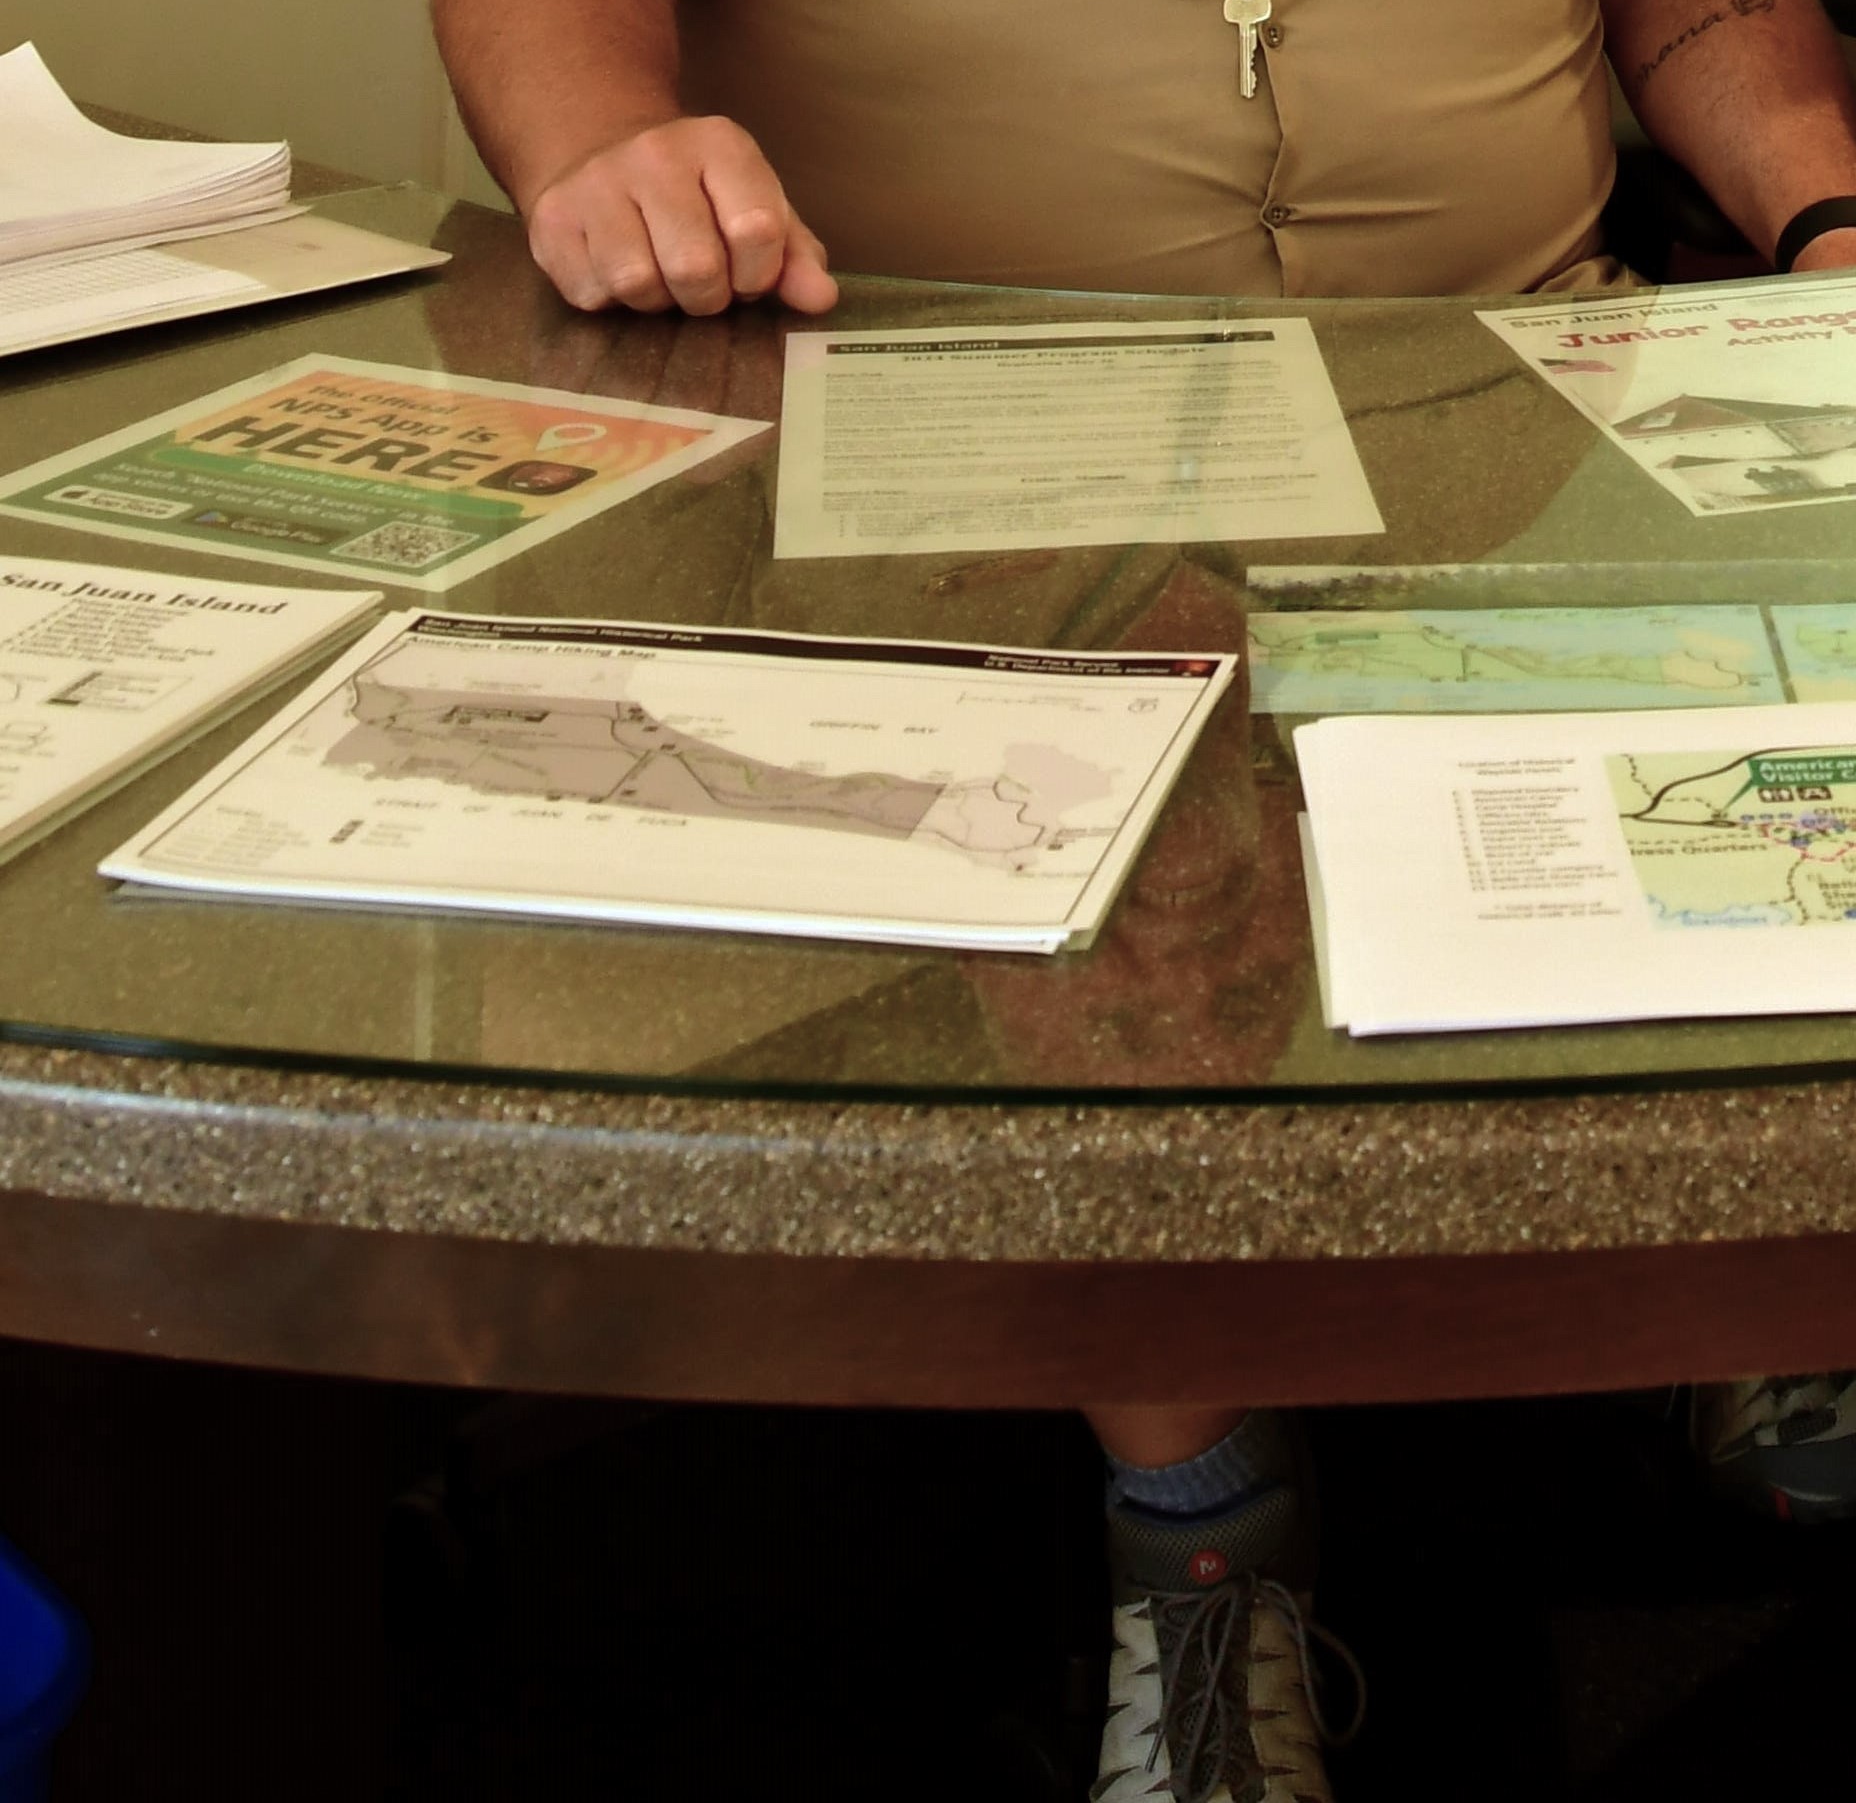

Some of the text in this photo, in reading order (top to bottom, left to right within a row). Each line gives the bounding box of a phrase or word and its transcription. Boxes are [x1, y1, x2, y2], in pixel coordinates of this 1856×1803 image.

[1510, 302, 1718, 329] San Juan Island
[838, 340, 1000, 353] San Juan Island
[1557, 324, 1709, 348] Junior
[1728, 329, 1833, 347] Activity
[950, 352, 1030, 362] Summer
[1034, 350, 1119, 359] Program
[1123, 347, 1206, 356] Schedule
[308, 385, 461, 416] The Official
[268, 397, 500, 444] NPS App is
[192, 416, 501, 482] HERE
[243, 462, 368, 496] Download
[1, 573, 290, 615] San Juan Island
[423, 617, 704, 643] San Juan Island National Historical Park
[405, 634, 658, 660] American Camp Hiking Map
[987, 654, 1040, 666] National
[1041, 658, 1071, 668] Park
[1011, 661, 1085, 674] Department
[1086, 665, 1101, 674] of
[1102, 665, 1124, 674] the
[1760, 769, 1836, 783] Visitor
[1682, 844, 1768, 855] Quarters
